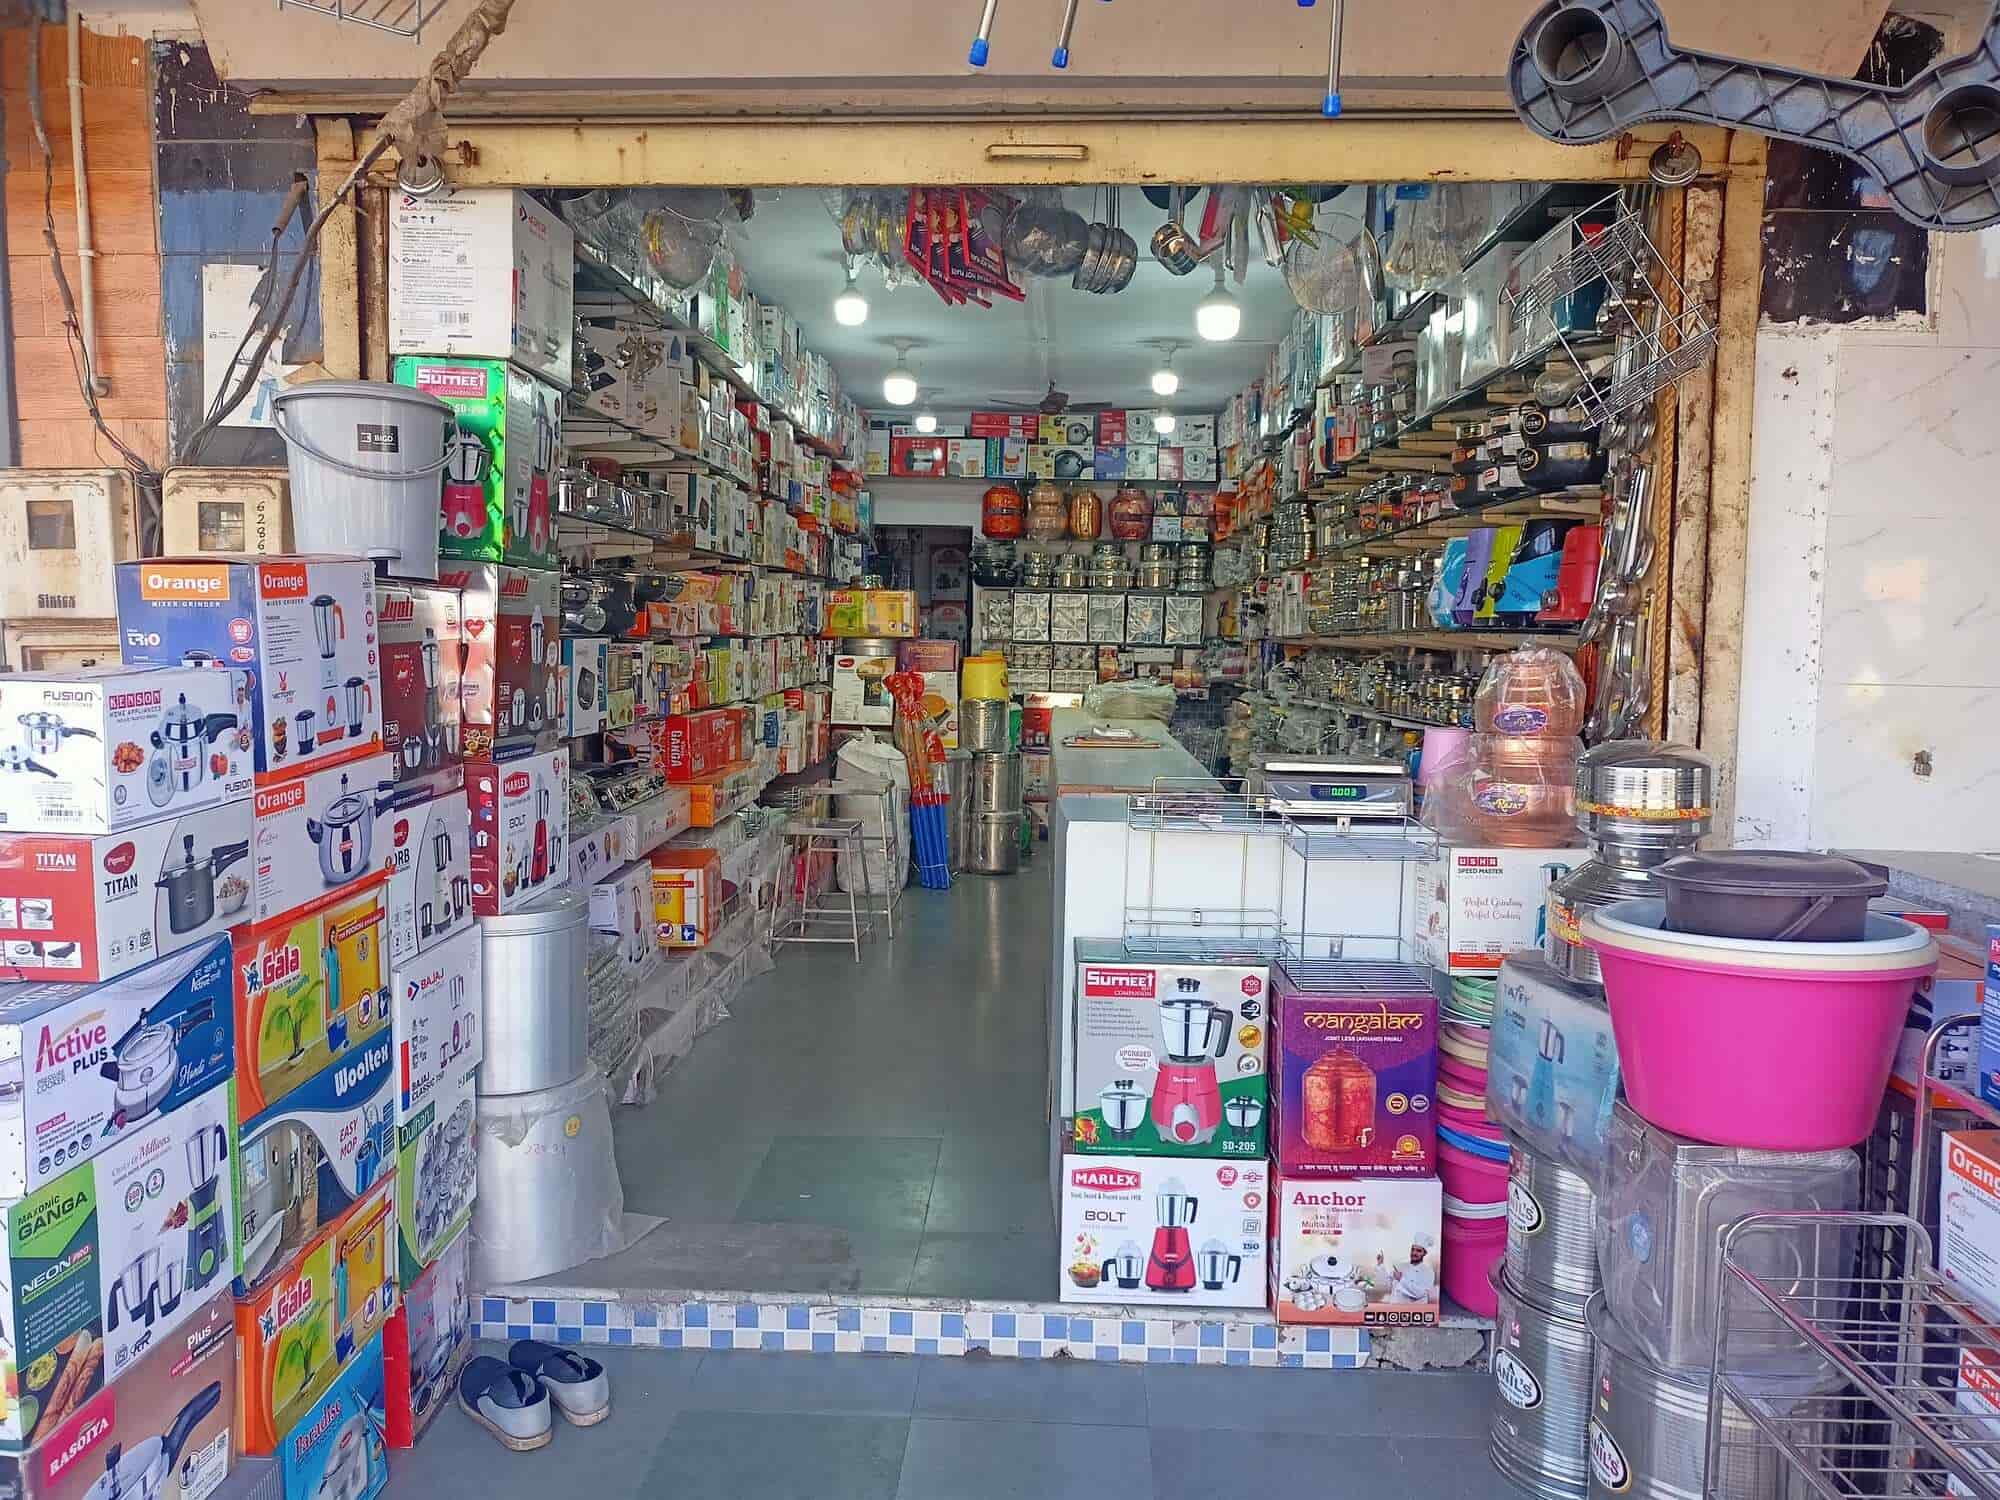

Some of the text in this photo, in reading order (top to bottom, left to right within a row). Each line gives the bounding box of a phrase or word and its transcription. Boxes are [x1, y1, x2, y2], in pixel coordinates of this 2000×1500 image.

[148, 573, 222, 592] Orange
[263, 573, 304, 591] Orange
[38, 593, 76, 609] Sintex
[257, 786, 302, 812] Orange
[35, 853, 77, 867] TITAN
[104, 873, 138, 897] TITAN
[1303, 1002, 1425, 1035] mangalam
[35, 1024, 107, 1073] Active
[73, 1047, 108, 1074] PLUS
[340, 1117, 359, 1143] EASY
[1074, 1172, 1136, 1186] MARLEX
[1293, 1191, 1366, 1207] Anchor
[19, 1191, 88, 1241] GANGA
[1084, 1210, 1126, 1223] BOLT
[21, 1256, 70, 1297] NEON
